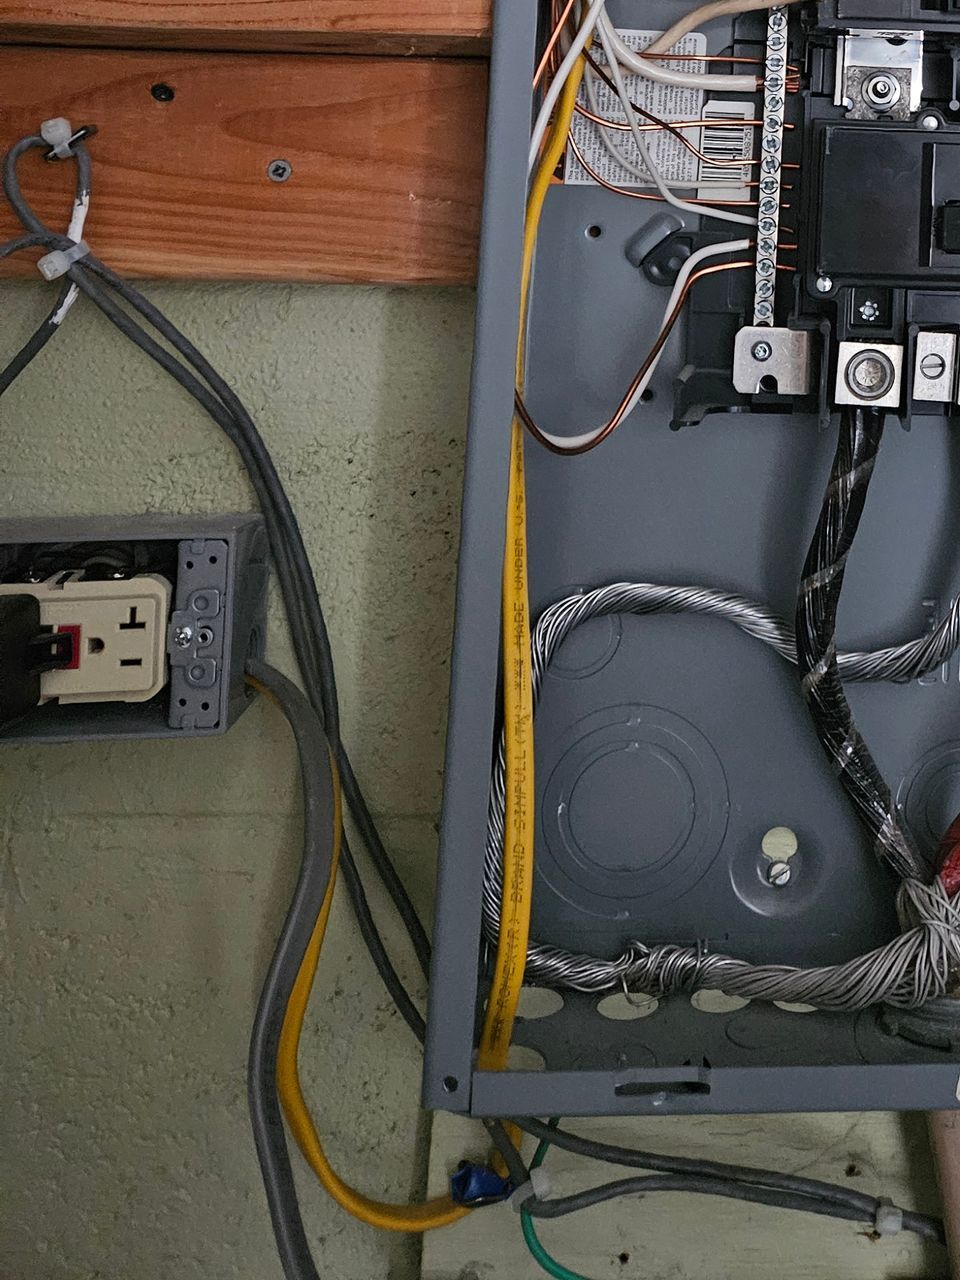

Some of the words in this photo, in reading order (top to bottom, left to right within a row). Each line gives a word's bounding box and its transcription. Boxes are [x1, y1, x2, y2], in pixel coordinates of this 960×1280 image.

[514, 538, 523, 591] UNDER
[513, 602, 524, 646] MADE
[510, 843, 526, 904] BRAND
